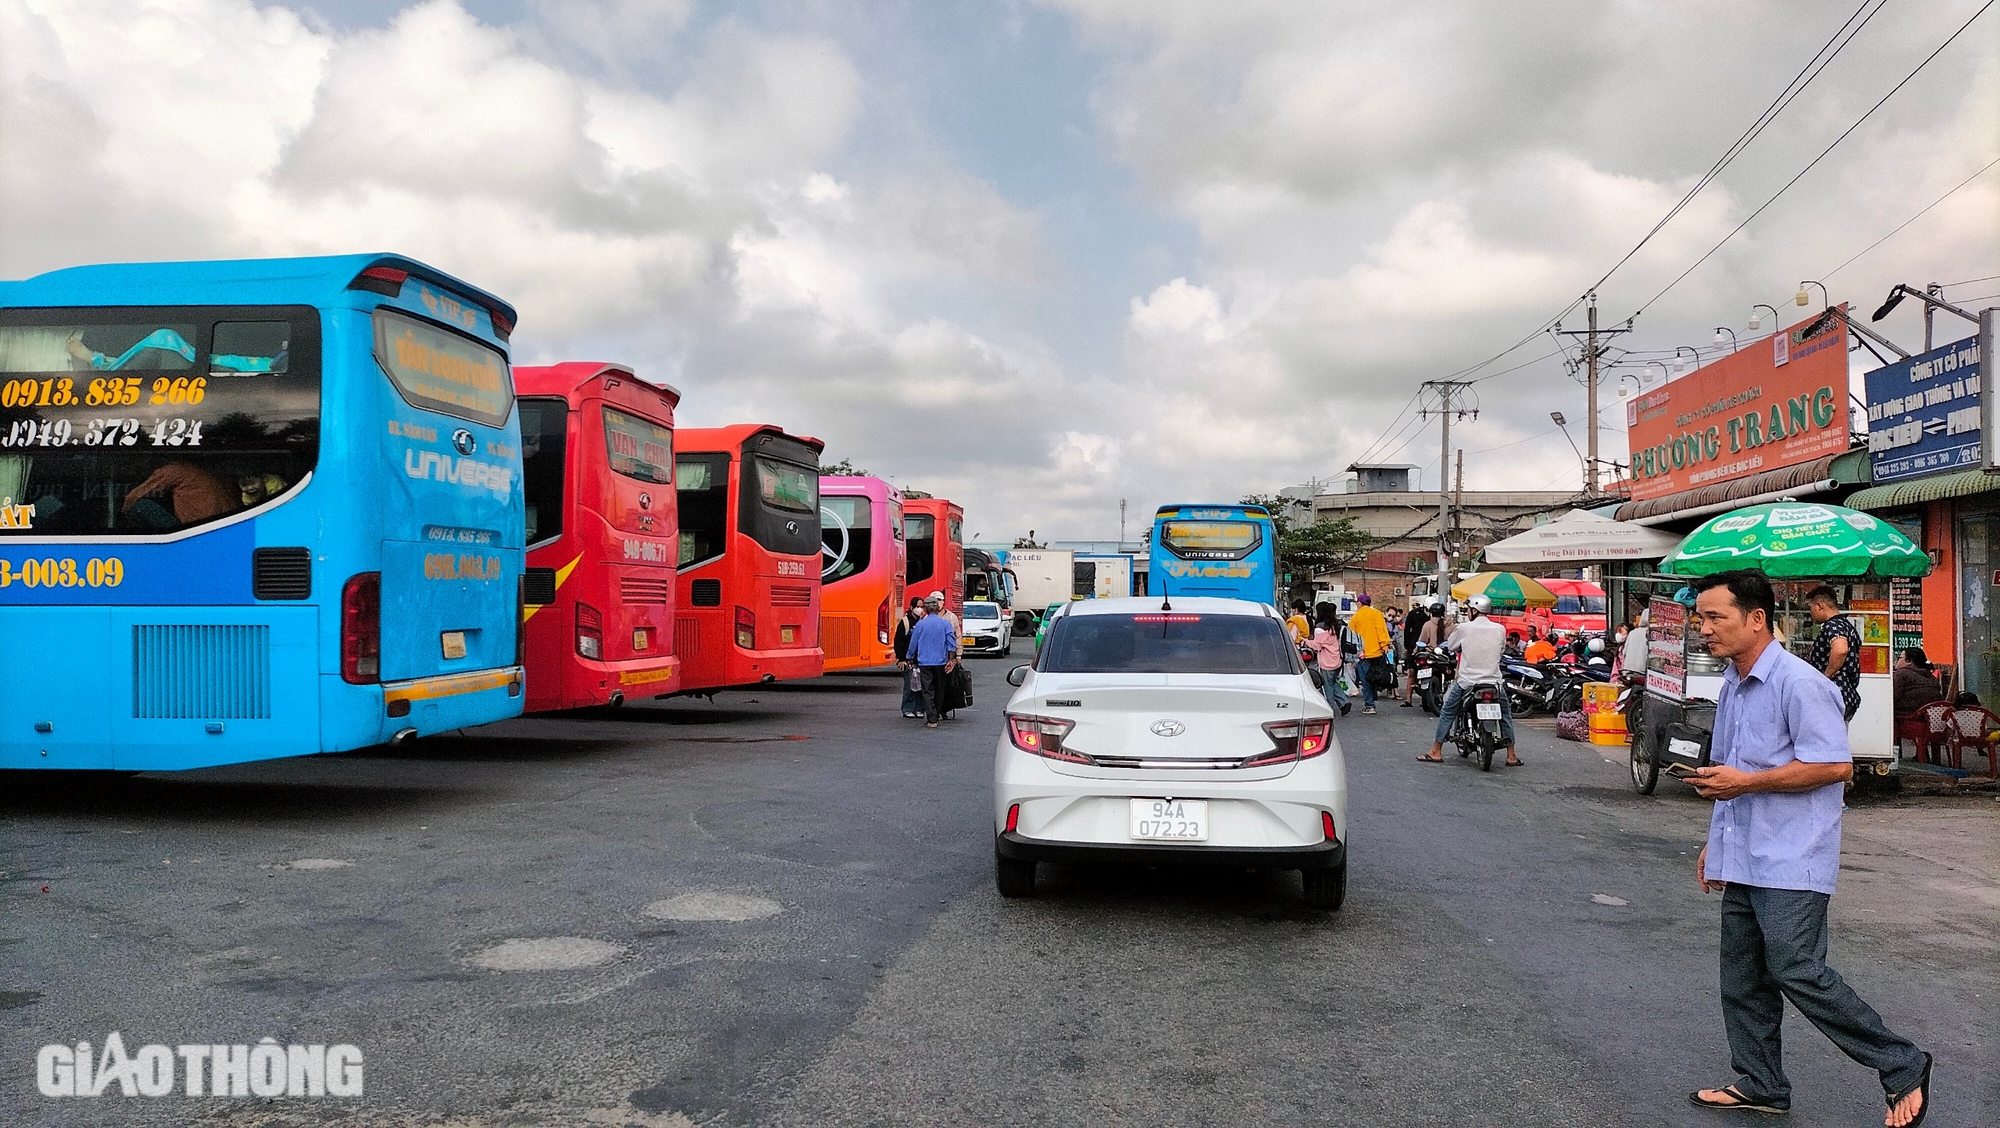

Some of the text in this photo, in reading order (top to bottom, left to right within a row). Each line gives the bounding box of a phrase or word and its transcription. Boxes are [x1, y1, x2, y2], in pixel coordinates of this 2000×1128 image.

[1910, 362, 1932, 383] CÔNG
[1933, 358, 1944, 376] TY
[1, 376, 207, 407] 0913. 835 266
[1905, 392, 1924, 413] GIAO
[1924, 383, 1952, 407] THÔNG
[149, 418, 203, 447] 424
[1631, 385, 1836, 482] PHƯƠNG TRANG
[405, 448, 512, 494] UNIVERSE
[1718, 518, 1759, 529] MILO
[1170, 567, 1252, 579] UNIVERSE
[1153, 802, 1185, 819] 94A
[1139, 820, 1199, 837] 072.23
